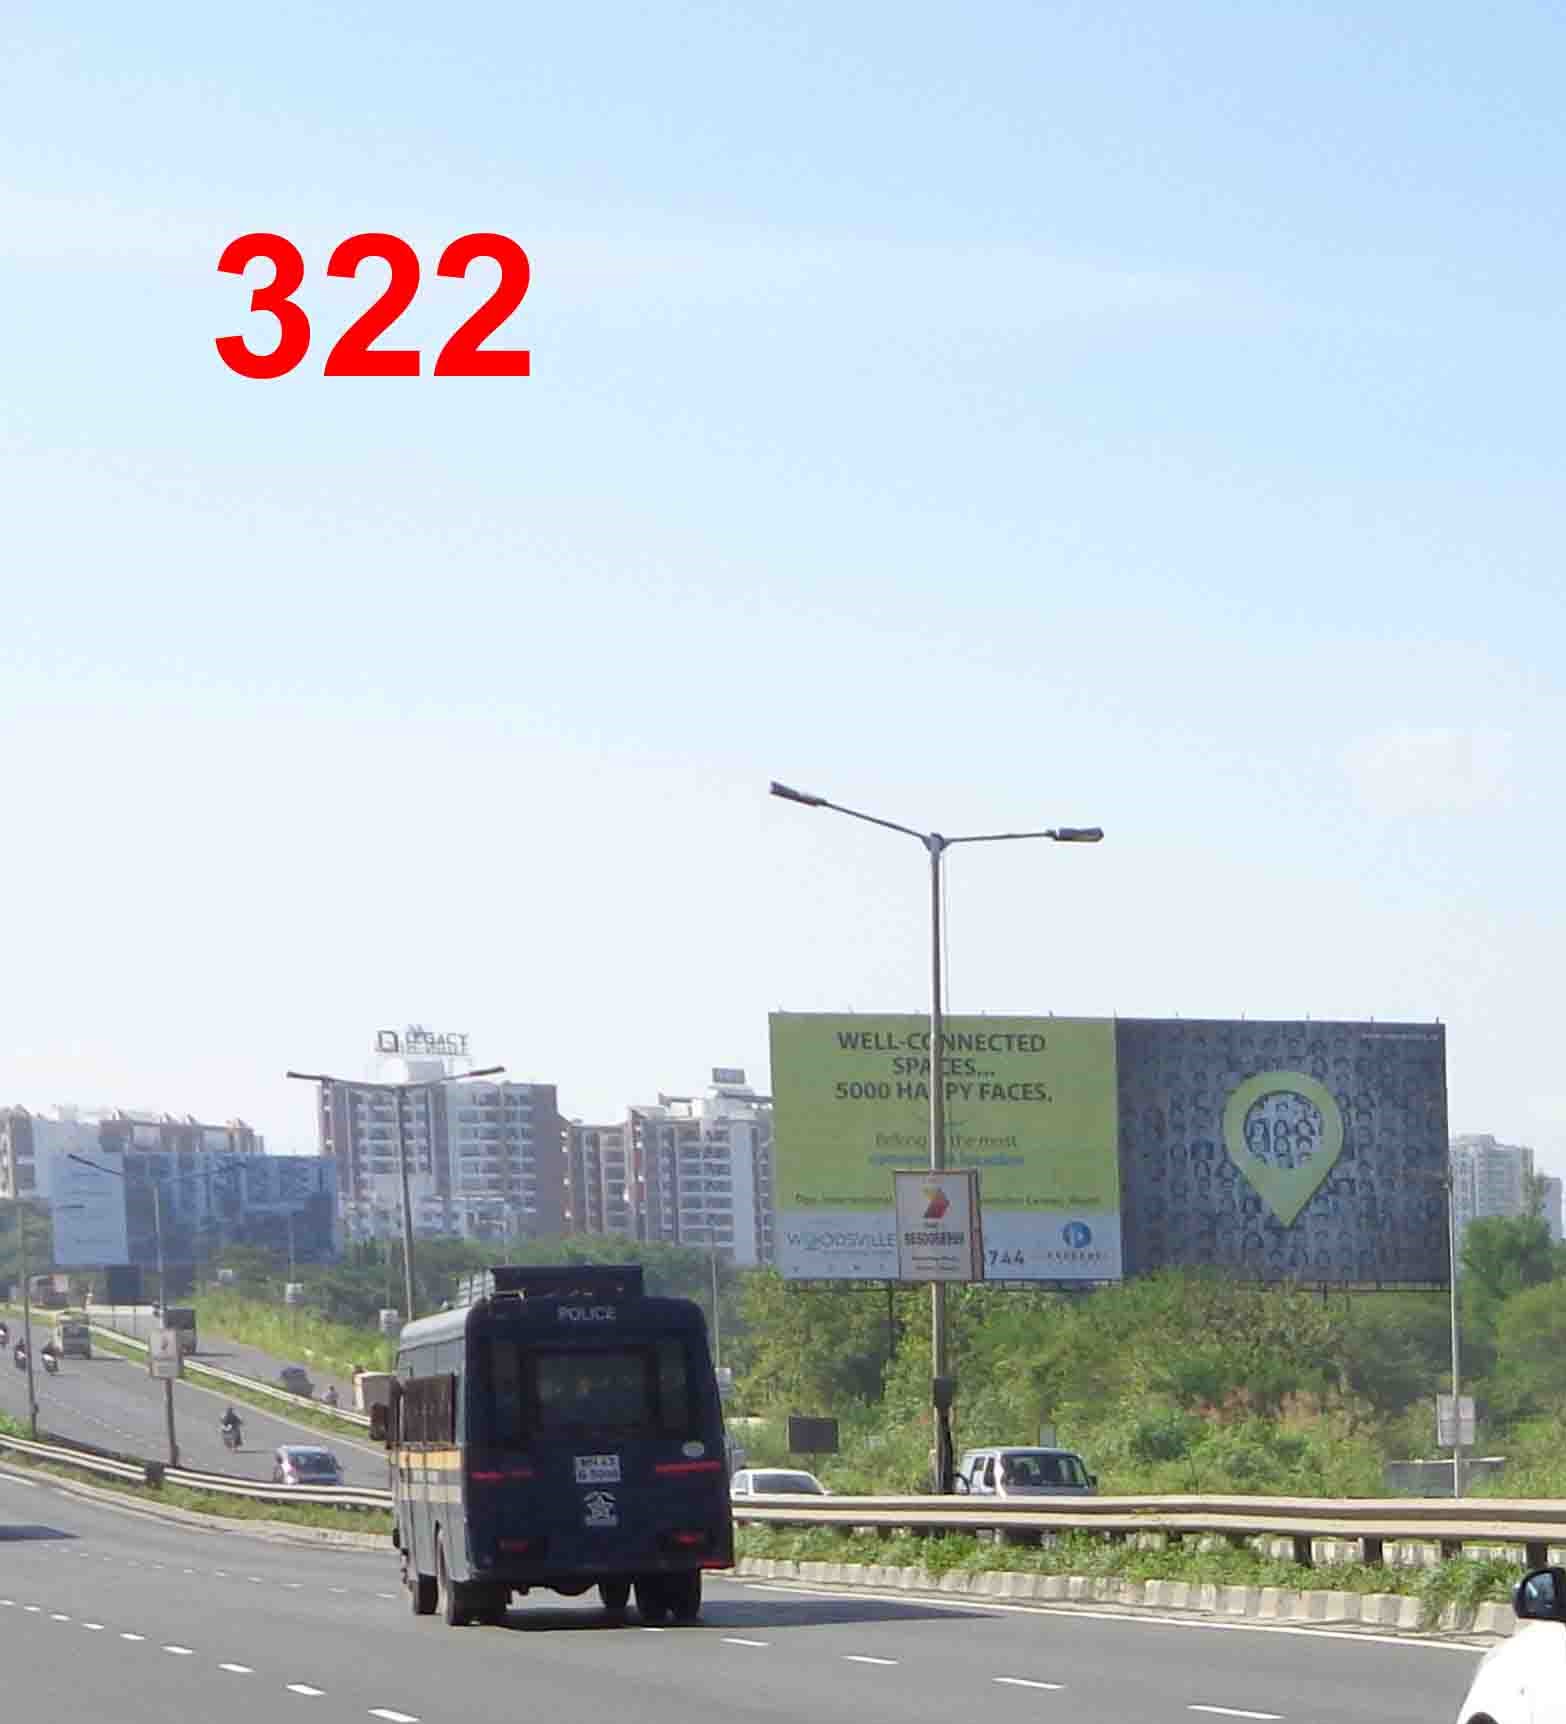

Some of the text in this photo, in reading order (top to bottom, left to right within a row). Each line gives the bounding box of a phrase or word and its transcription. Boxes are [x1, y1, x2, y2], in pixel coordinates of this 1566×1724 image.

[835, 1082, 889, 1100] 5000
[896, 1082, 974, 1101] HAPY
[558, 1305, 617, 1321] POLICE
